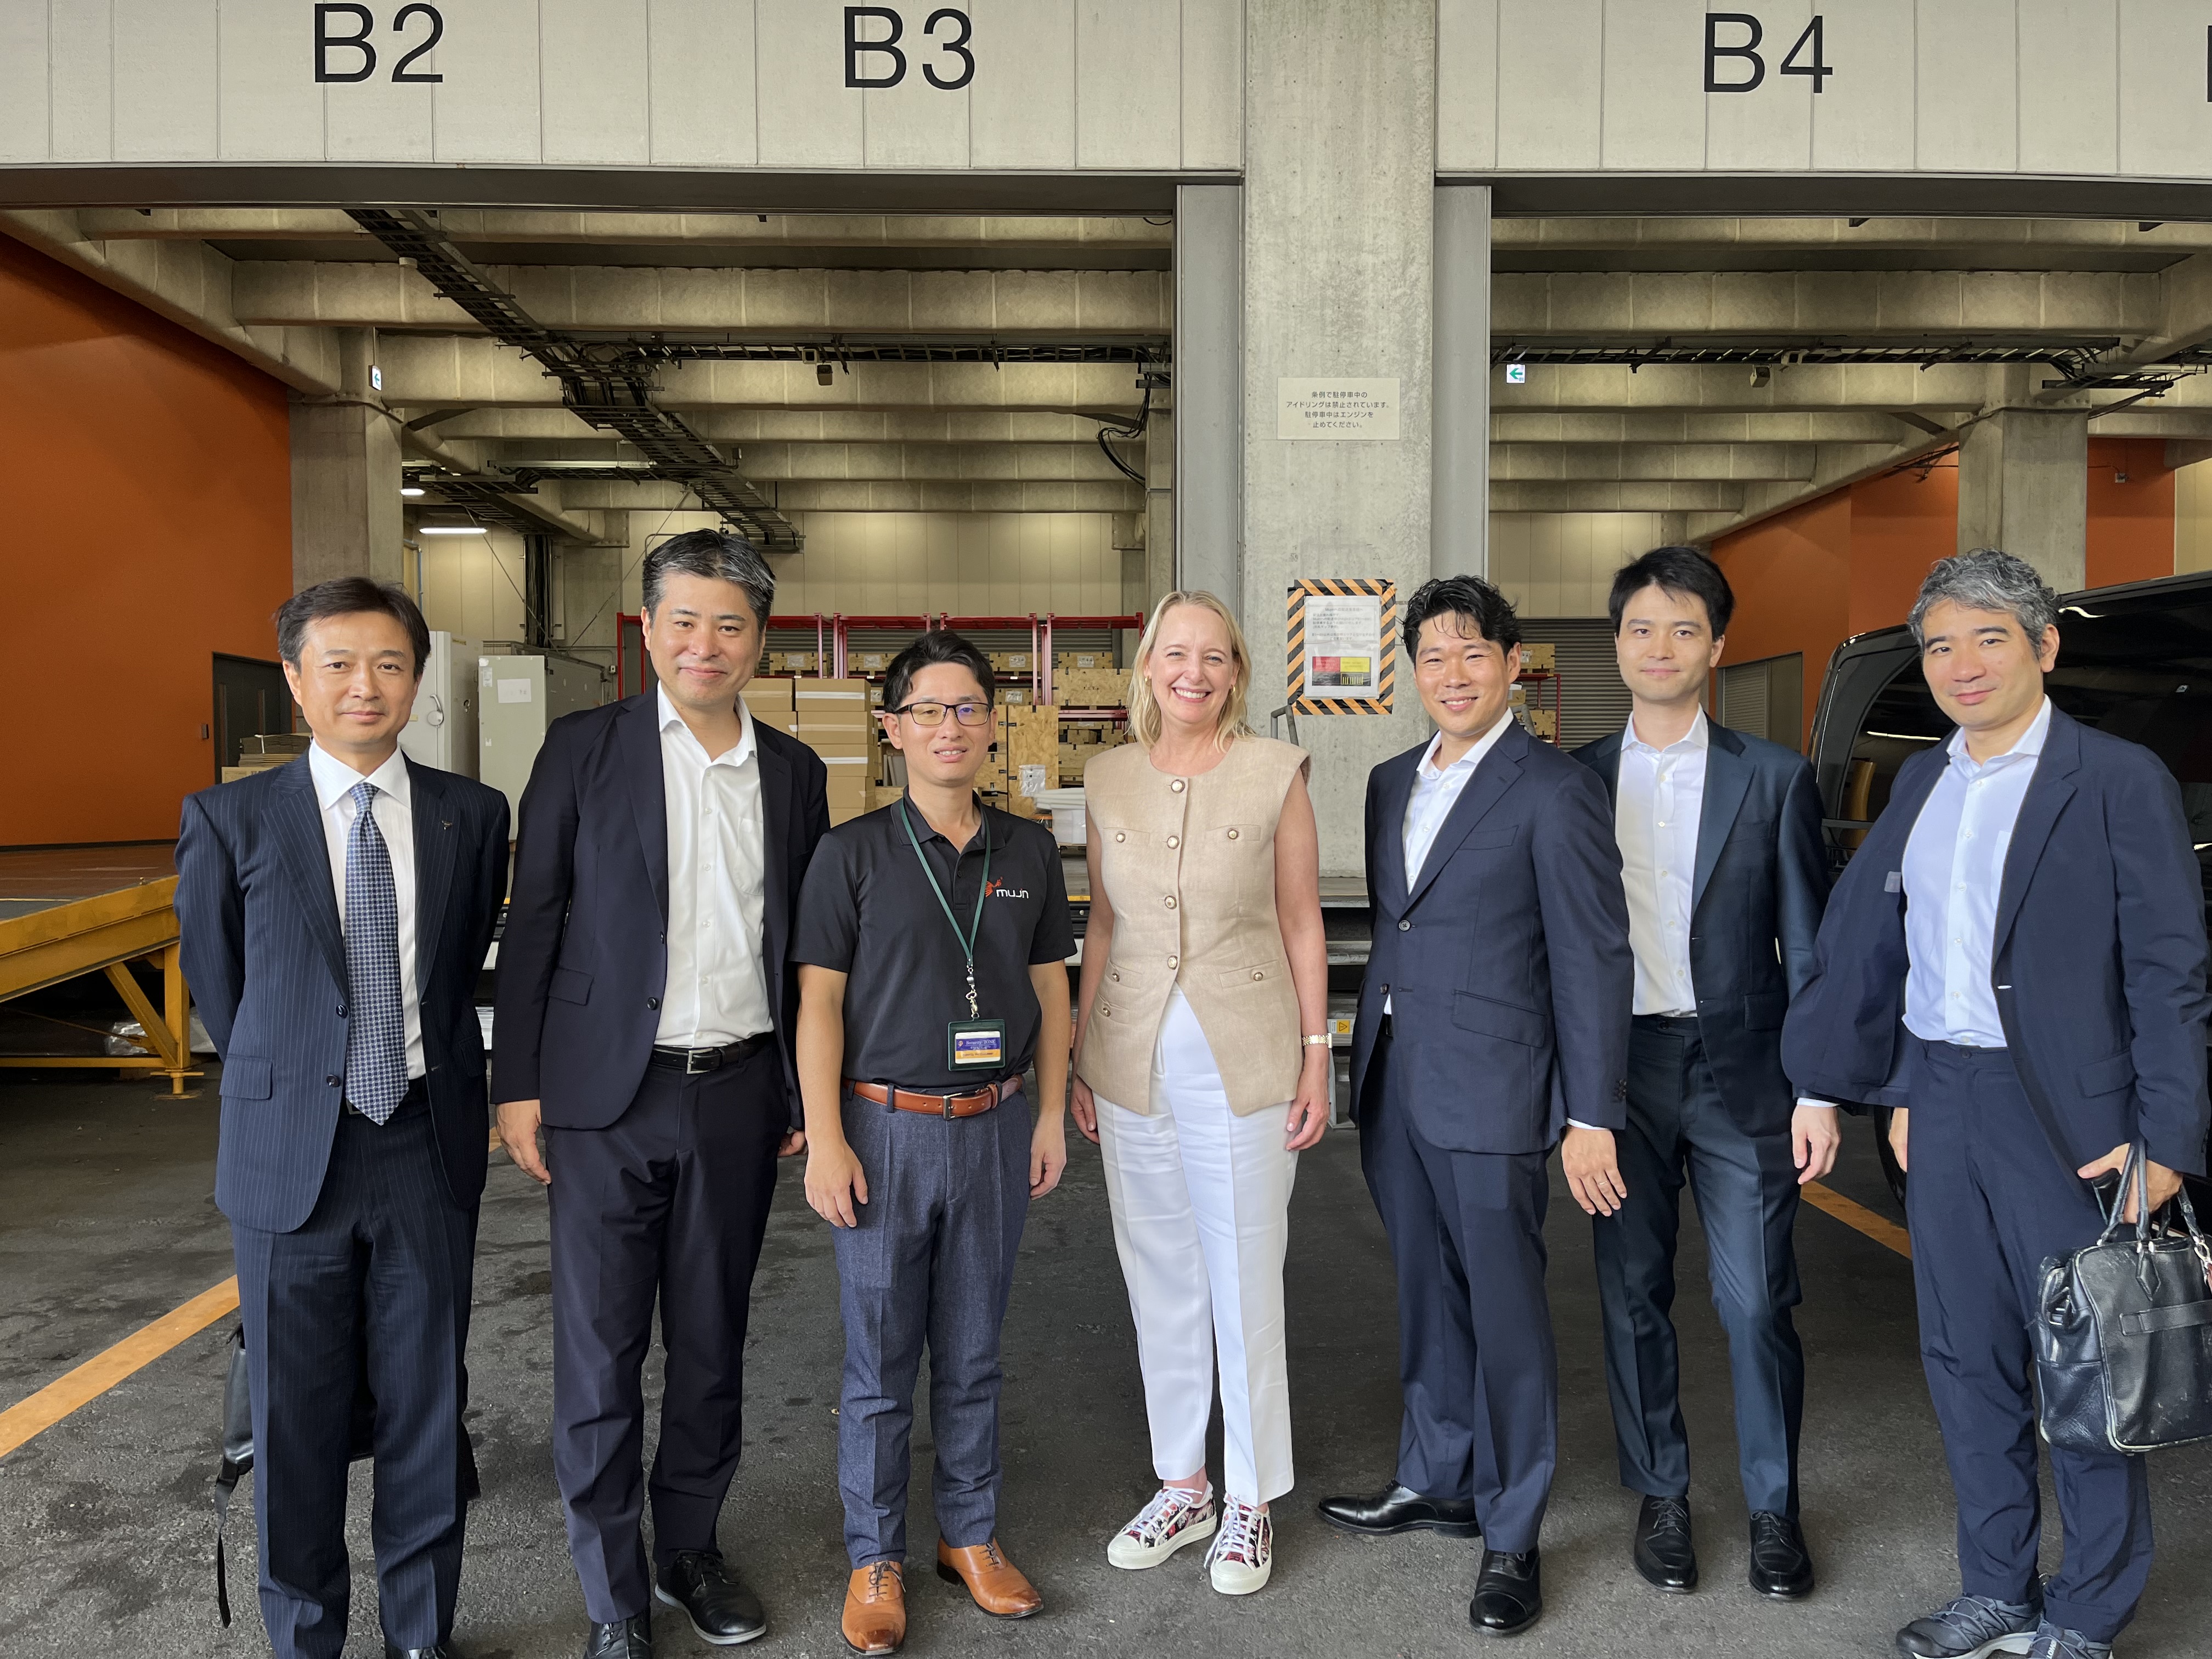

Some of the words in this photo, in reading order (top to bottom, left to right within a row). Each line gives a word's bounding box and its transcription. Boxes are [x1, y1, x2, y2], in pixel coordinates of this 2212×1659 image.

[314, 3, 443, 83] B2
[844, 6, 975, 90] B3
[1703, 13, 1833, 93] B4
